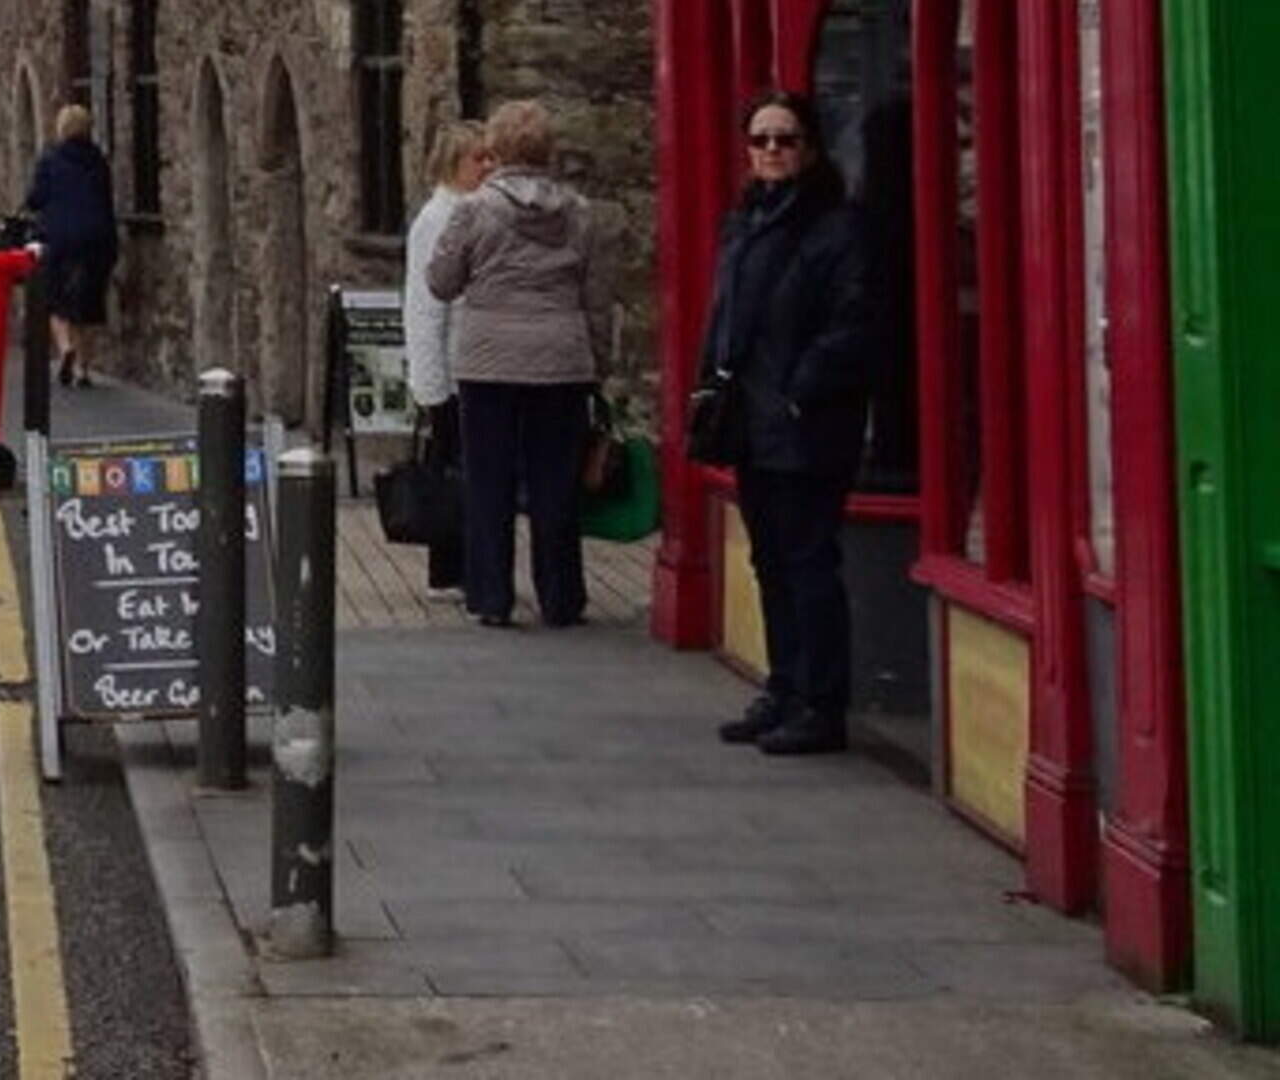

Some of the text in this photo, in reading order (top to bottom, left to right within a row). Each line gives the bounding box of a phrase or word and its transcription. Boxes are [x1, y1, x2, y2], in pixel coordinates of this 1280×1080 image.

[57, 497, 133, 538] Best
[106, 544, 134, 574] In
[117, 591, 170, 619] Eat
[68, 629, 111, 654] Or
[121, 626, 193, 651] Take
[94, 674, 159, 707] Beer
